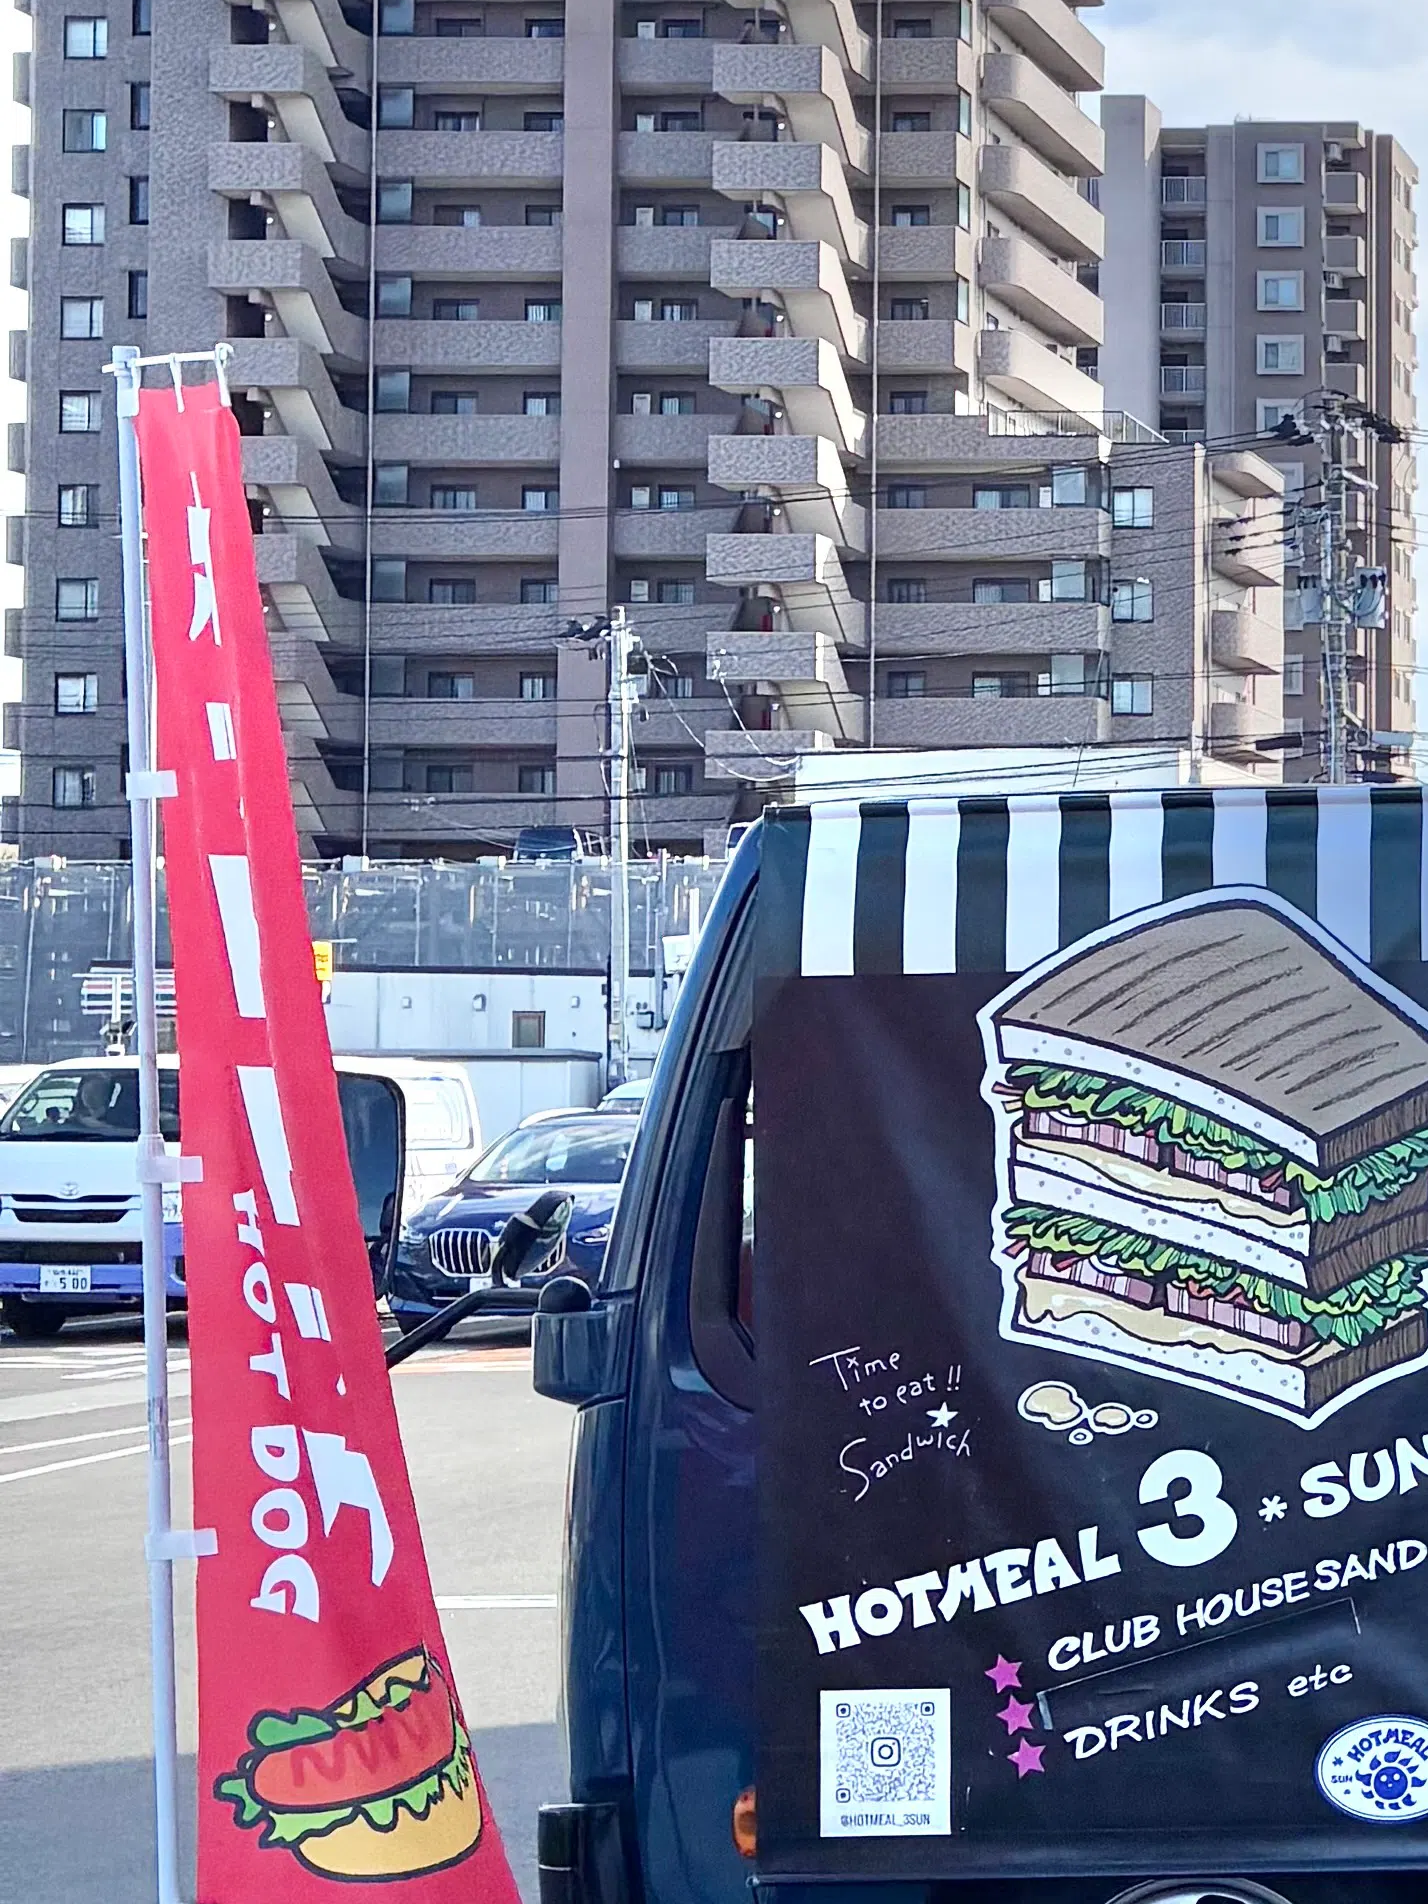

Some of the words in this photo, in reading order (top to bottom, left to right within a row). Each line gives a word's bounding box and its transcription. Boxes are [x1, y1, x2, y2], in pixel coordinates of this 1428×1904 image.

[232, 1188, 292, 1401] HOT
[809, 1346, 900, 1391] Time
[859, 1396, 888, 1416] to
[896, 1373, 936, 1405] eat
[839, 1429, 971, 1502] Sandwich
[249, 1424, 320, 1623] DOG
[799, 1525, 1122, 1655] HOTMEAL
[1136, 1449, 1239, 1568] 3
[1047, 1613, 1161, 1672] CLUB
[1063, 1678, 1261, 1761] DRINKS
[1287, 1661, 1353, 1698] etc
